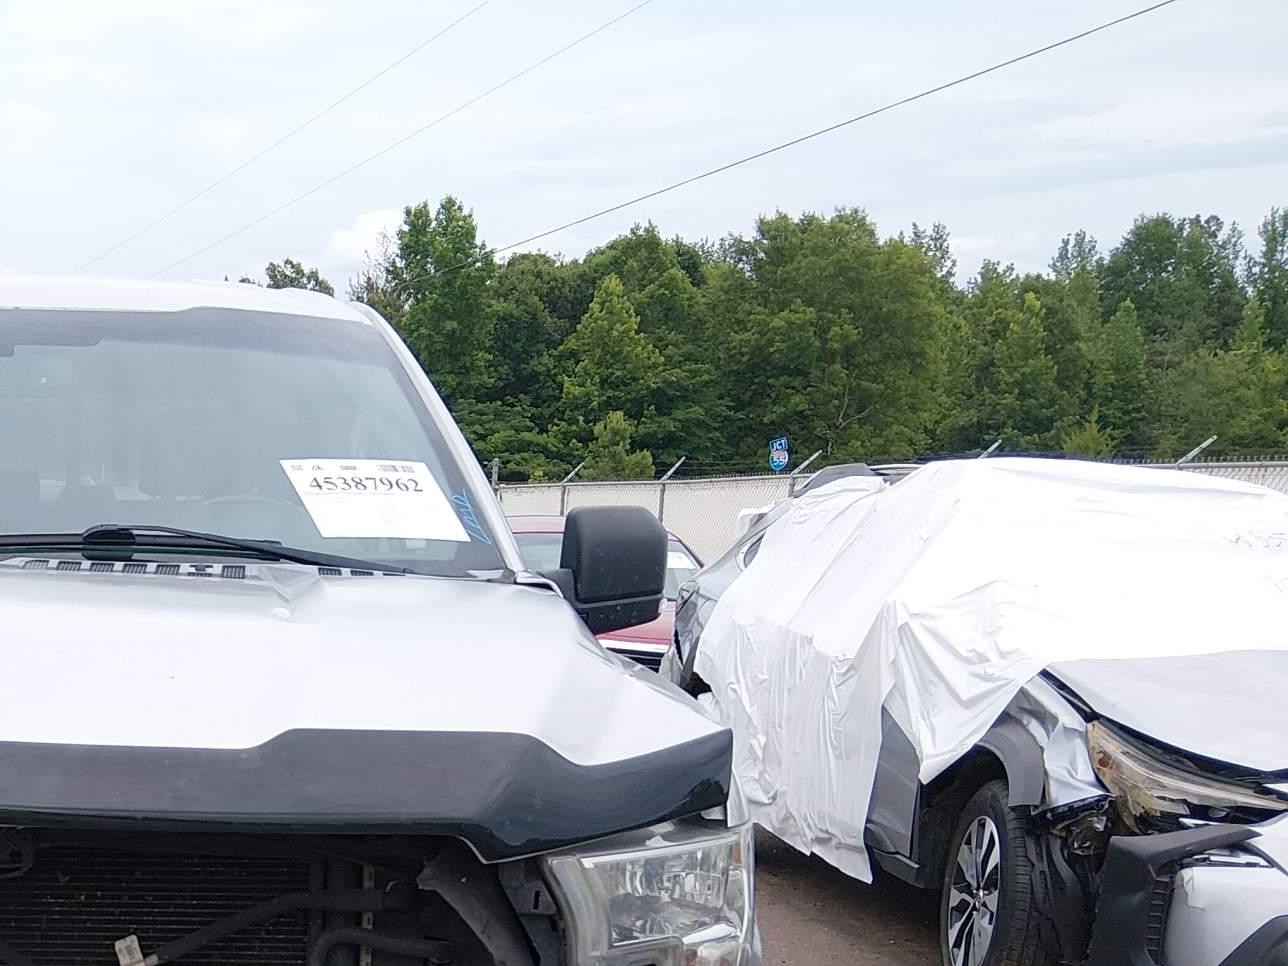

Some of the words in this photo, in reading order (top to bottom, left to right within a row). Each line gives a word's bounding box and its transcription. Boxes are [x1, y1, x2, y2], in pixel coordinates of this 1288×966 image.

[772, 439, 785, 451] JCT
[773, 455, 785, 465] 55
[309, 476, 424, 493] 45387962
